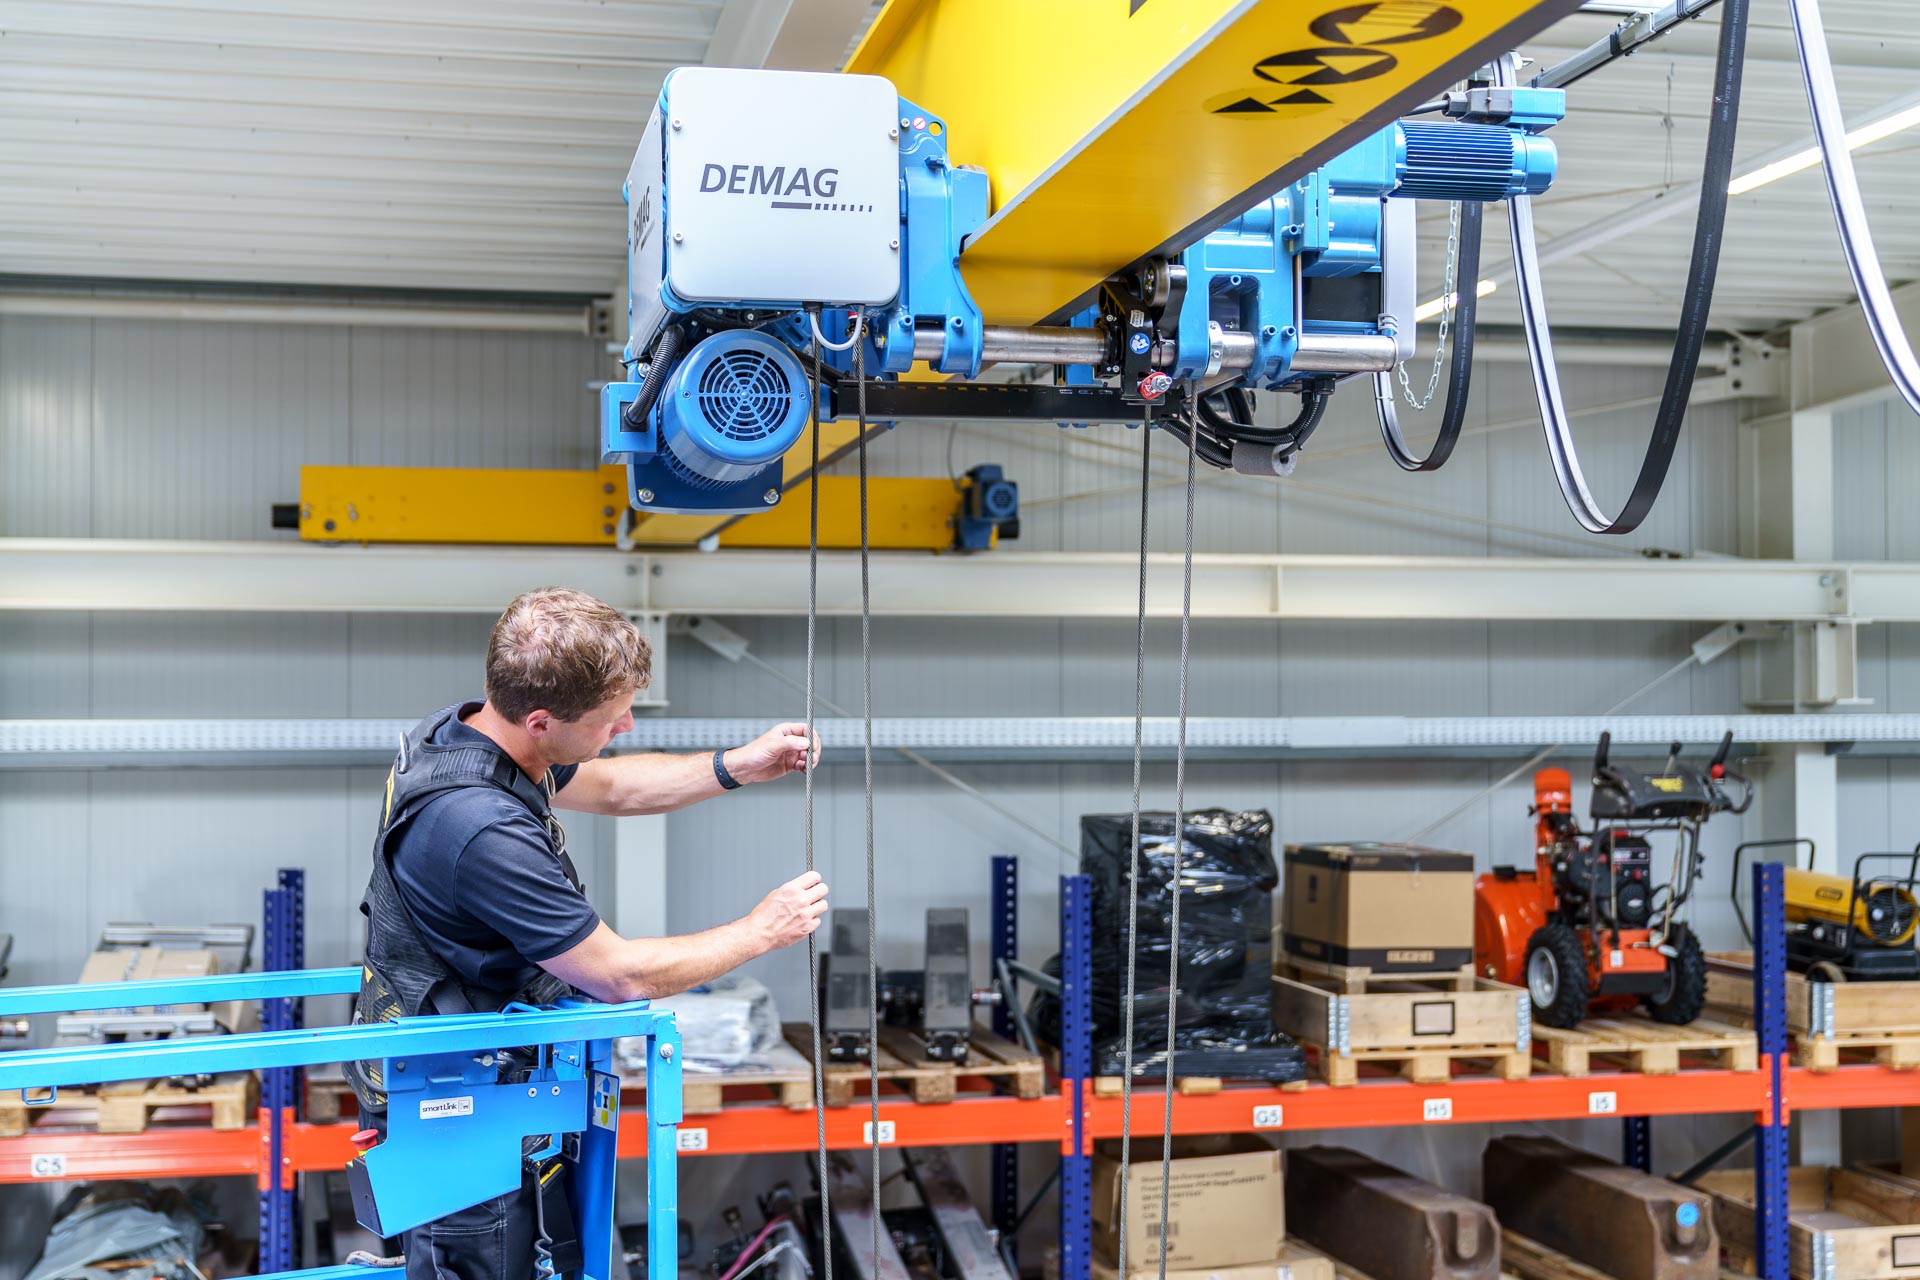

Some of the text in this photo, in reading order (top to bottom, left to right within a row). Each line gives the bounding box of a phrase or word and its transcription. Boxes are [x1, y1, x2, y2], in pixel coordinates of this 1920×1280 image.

[699, 163, 839, 198] DEMAG
[633, 185, 650, 256] DEMAG
[1257, 1109, 1278, 1124] G5
[1427, 1103, 1448, 1118] H5
[680, 1132, 704, 1148] E5
[35, 1157, 62, 1175] C5
